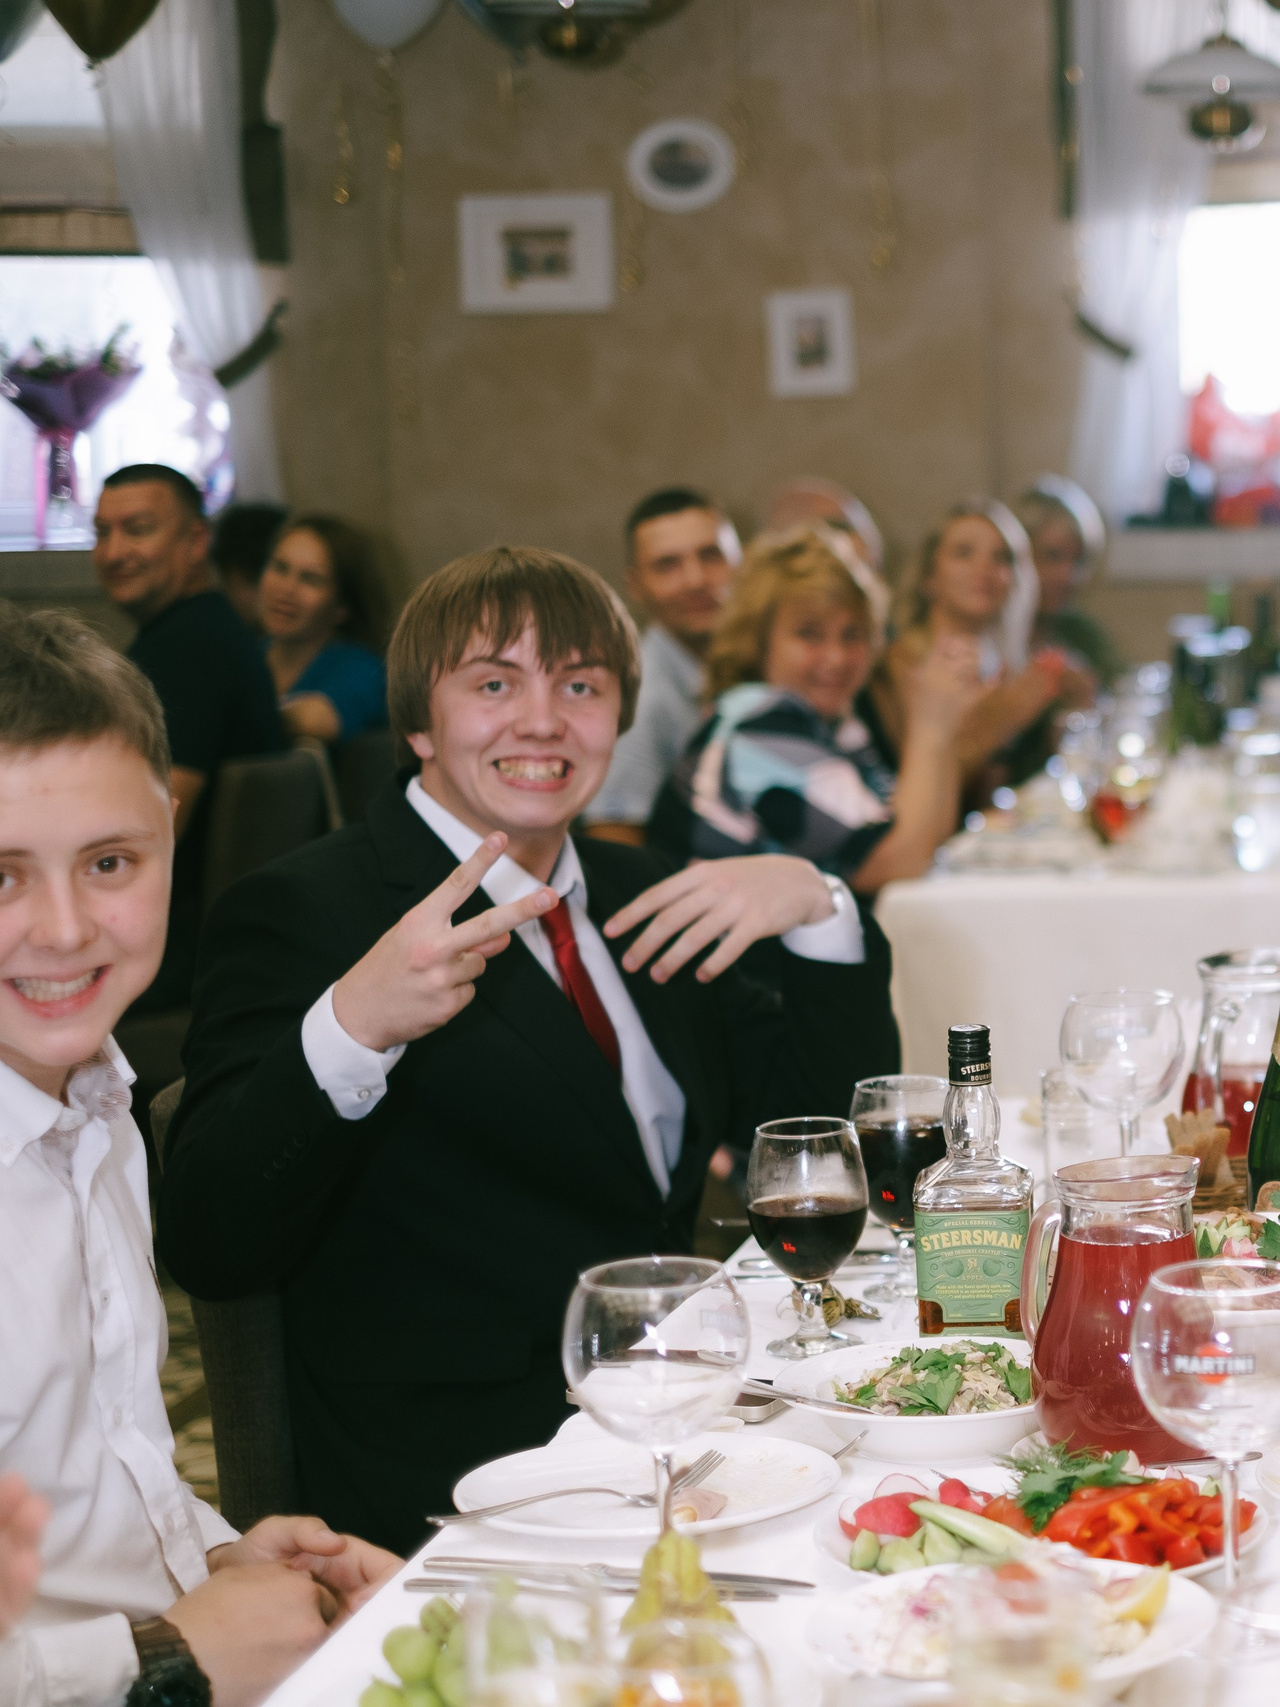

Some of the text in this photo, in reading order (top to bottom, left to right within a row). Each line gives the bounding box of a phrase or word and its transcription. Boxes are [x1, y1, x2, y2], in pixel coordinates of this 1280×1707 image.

[944, 1220, 968, 1228] SPECIAL
[921, 1229, 1022, 1251] STEERSMAN
[954, 1248, 978, 1256] ORIGINAL
[1174, 1355, 1254, 1374] MARTINI
